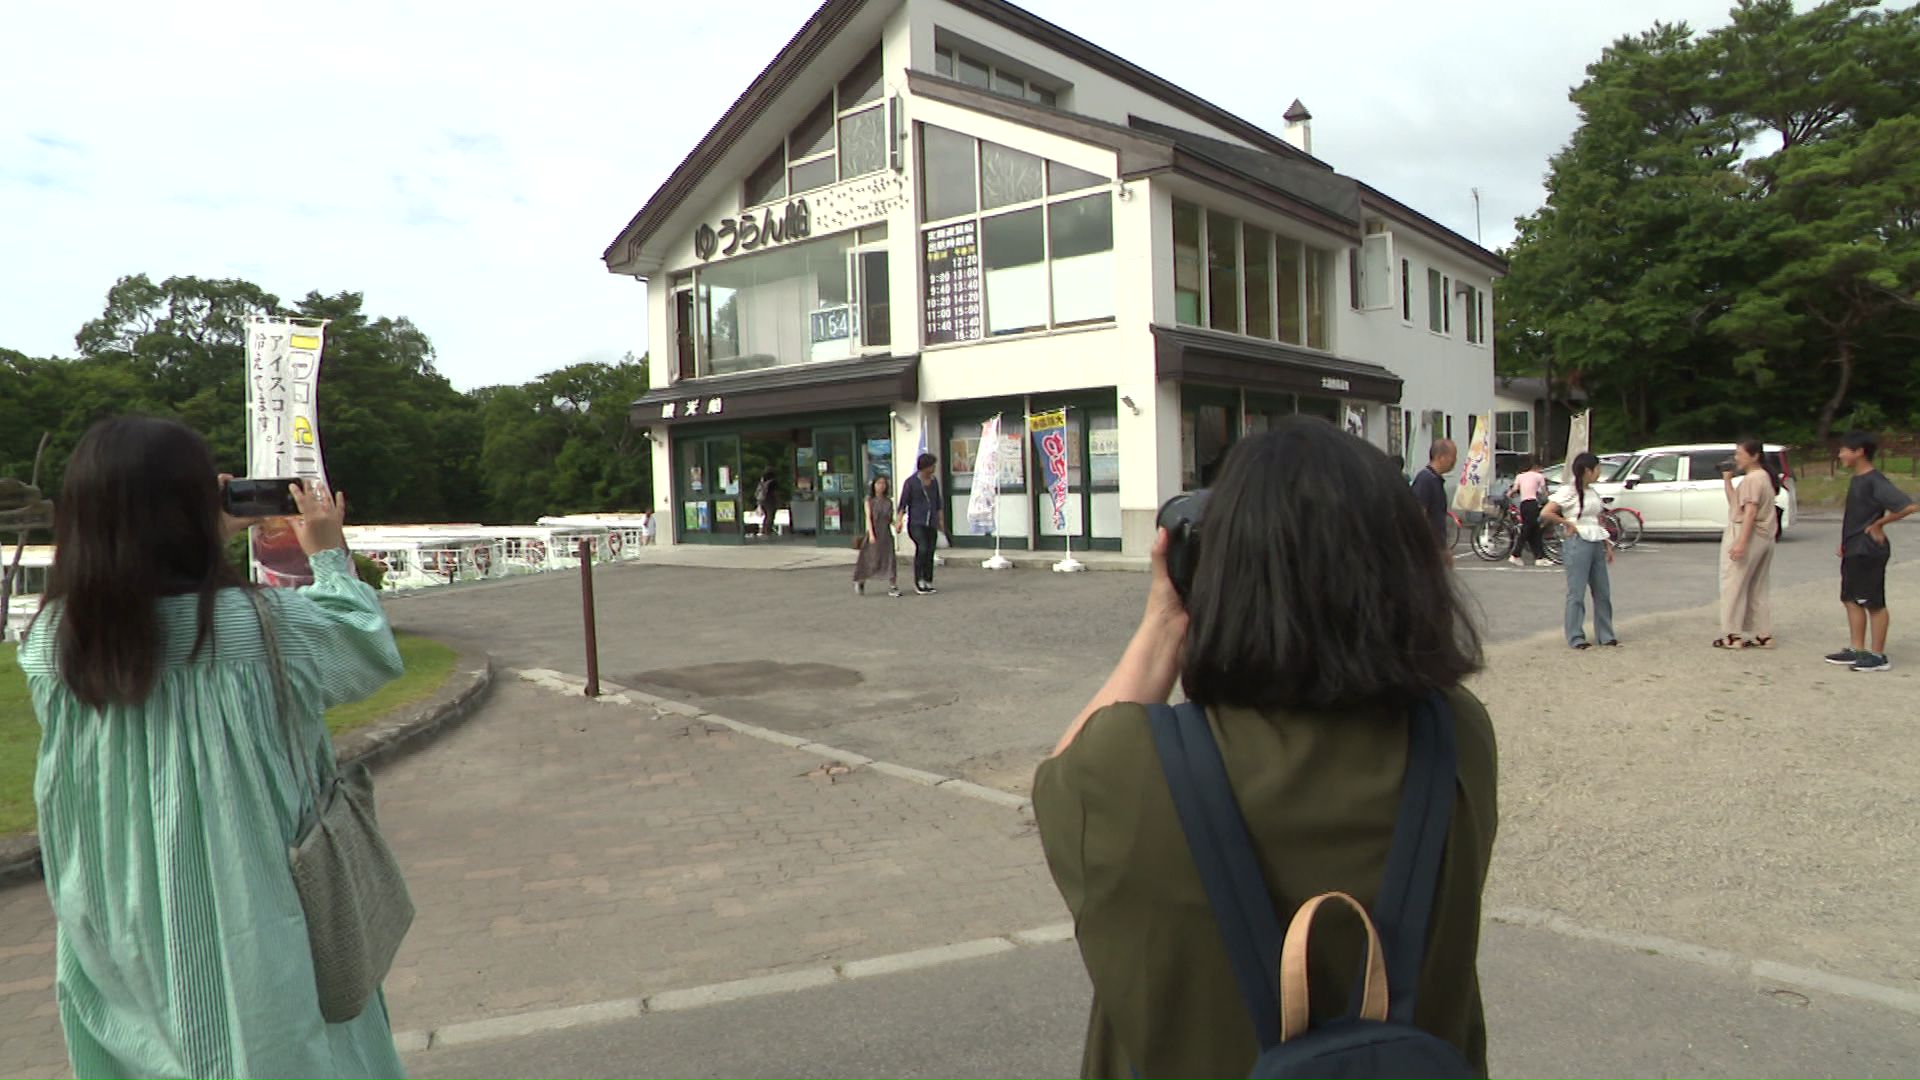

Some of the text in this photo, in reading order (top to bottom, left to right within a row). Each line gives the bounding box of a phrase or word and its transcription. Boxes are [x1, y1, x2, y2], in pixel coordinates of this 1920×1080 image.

[695, 197, 811, 261] ゆうらん船
[952, 255, 977, 267] 12:20
[953, 267, 977, 280] 13:00
[930, 284, 951, 296] 9:40
[927, 292, 978, 309] 10:20 14:20
[927, 305, 978, 321] 11:00 15:00
[928, 320, 952, 333] 11:40
[269, 334, 285, 477] アイスコーヒー
